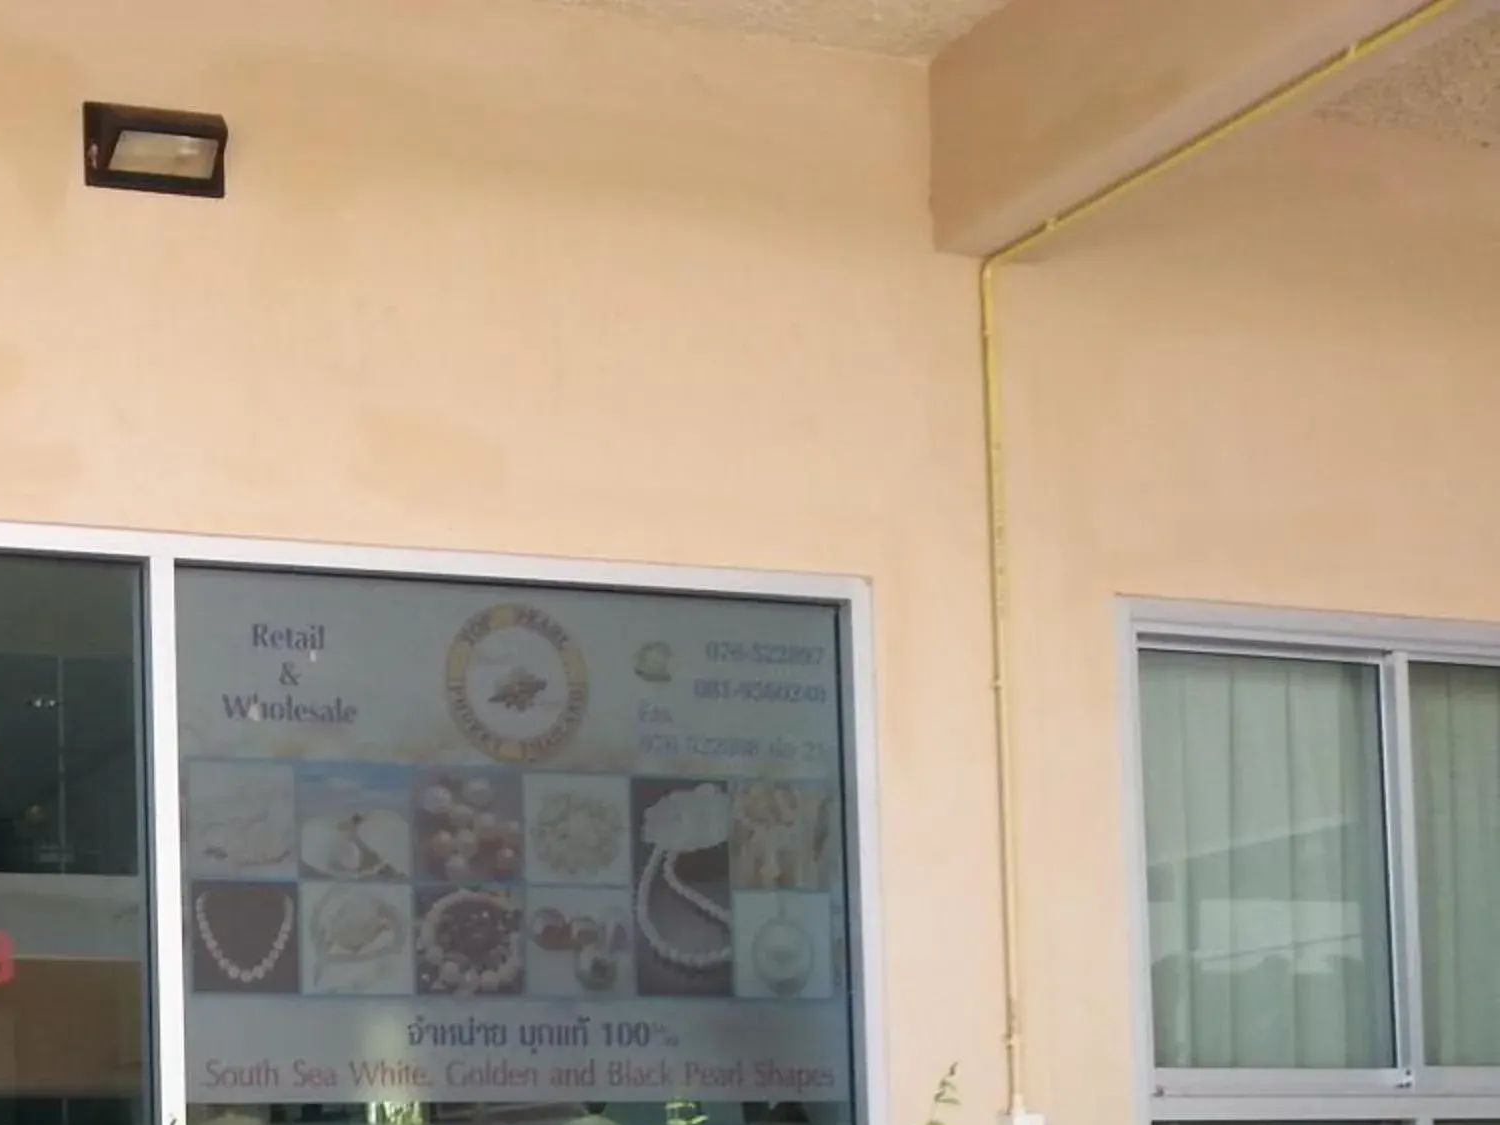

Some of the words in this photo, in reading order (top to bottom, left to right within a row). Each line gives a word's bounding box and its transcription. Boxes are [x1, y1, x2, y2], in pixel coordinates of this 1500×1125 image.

[250, 622, 326, 651] Retail
[278, 660, 302, 687] &
[221, 692, 359, 724] Wholesale
[406, 1015, 508, 1047] จำหน่าย
[519, 1015, 591, 1055] มุกแท้
[203, 1058, 279, 1089] South
[292, 1058, 339, 1089] Sea
[446, 1057, 539, 1090] Golden
[548, 1058, 596, 1089] and
[607, 1057, 672, 1089] Black
[684, 1057, 744, 1089] Pearl
[753, 1058, 836, 1094] Shapes
